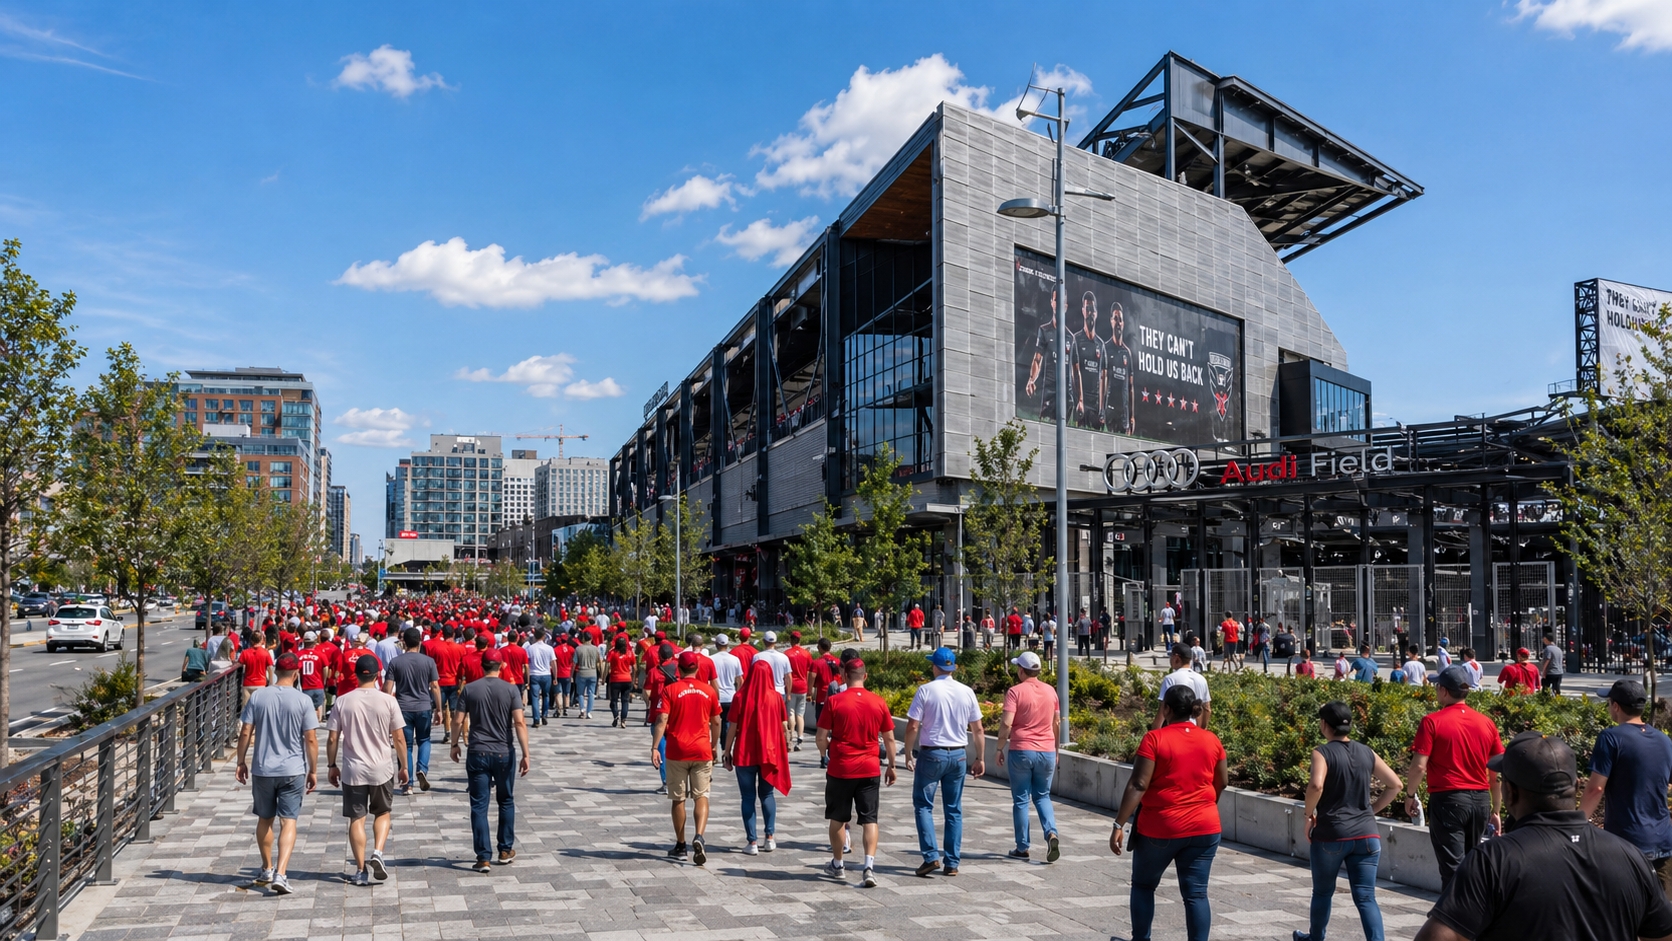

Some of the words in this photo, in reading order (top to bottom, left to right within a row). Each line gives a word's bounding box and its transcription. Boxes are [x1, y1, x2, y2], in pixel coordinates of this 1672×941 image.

[1607, 310, 1631, 330] HOLD
[1139, 325, 1165, 350] THEY
[1167, 334, 1194, 359] CAN'T
[1138, 351, 1163, 376] HOLD
[1167, 359, 1179, 379] US
[1181, 362, 1204, 386] BACK
[1220, 454, 1297, 484] Audi
[1311, 446, 1393, 477] Field
[303, 660, 315, 675] 10
